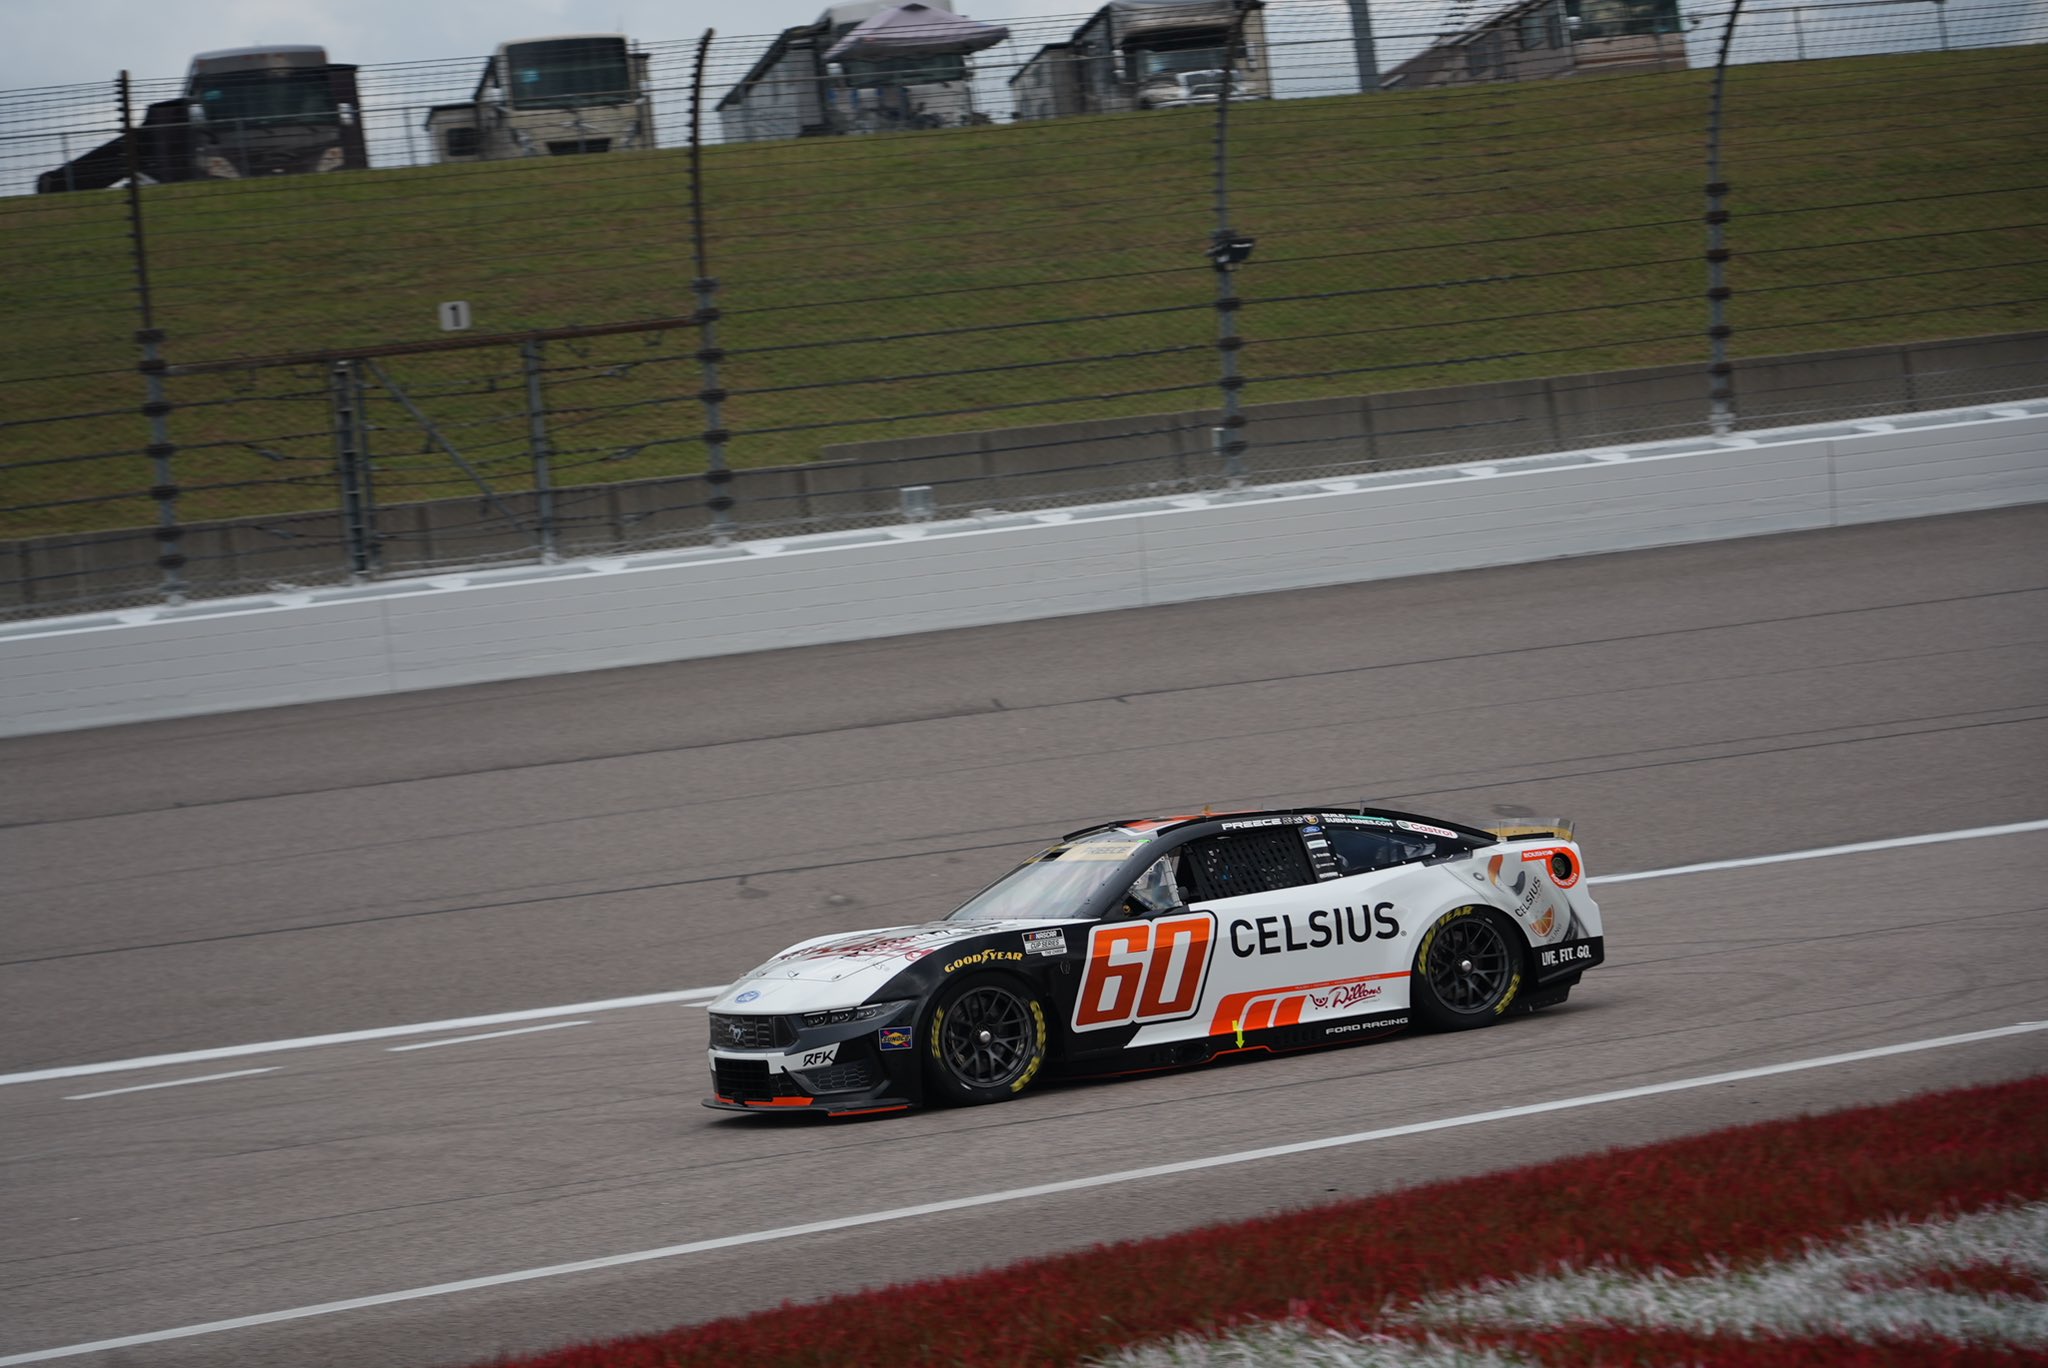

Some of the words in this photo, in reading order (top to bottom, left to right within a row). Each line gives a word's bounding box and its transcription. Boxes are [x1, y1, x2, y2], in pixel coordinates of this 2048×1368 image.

[448, 303, 462, 328] 1
[1221, 818, 1282, 830] PREECE
[1411, 823, 1454, 837] Castrol
[1514, 876, 1541, 917] CELSIUS
[1230, 902, 1400, 958] CELSIUS
[944, 949, 1024, 973] GOODYEAR
[1560, 947, 1577, 963] FIT.
[1577, 944, 1592, 959] GO.
[1074, 916, 1212, 1028] 60
[1325, 1024, 1358, 1035] FORD
[1362, 1017, 1409, 1030] RACING
[881, 1034, 911, 1043] SUNOCO
[803, 1050, 835, 1067] RFK
